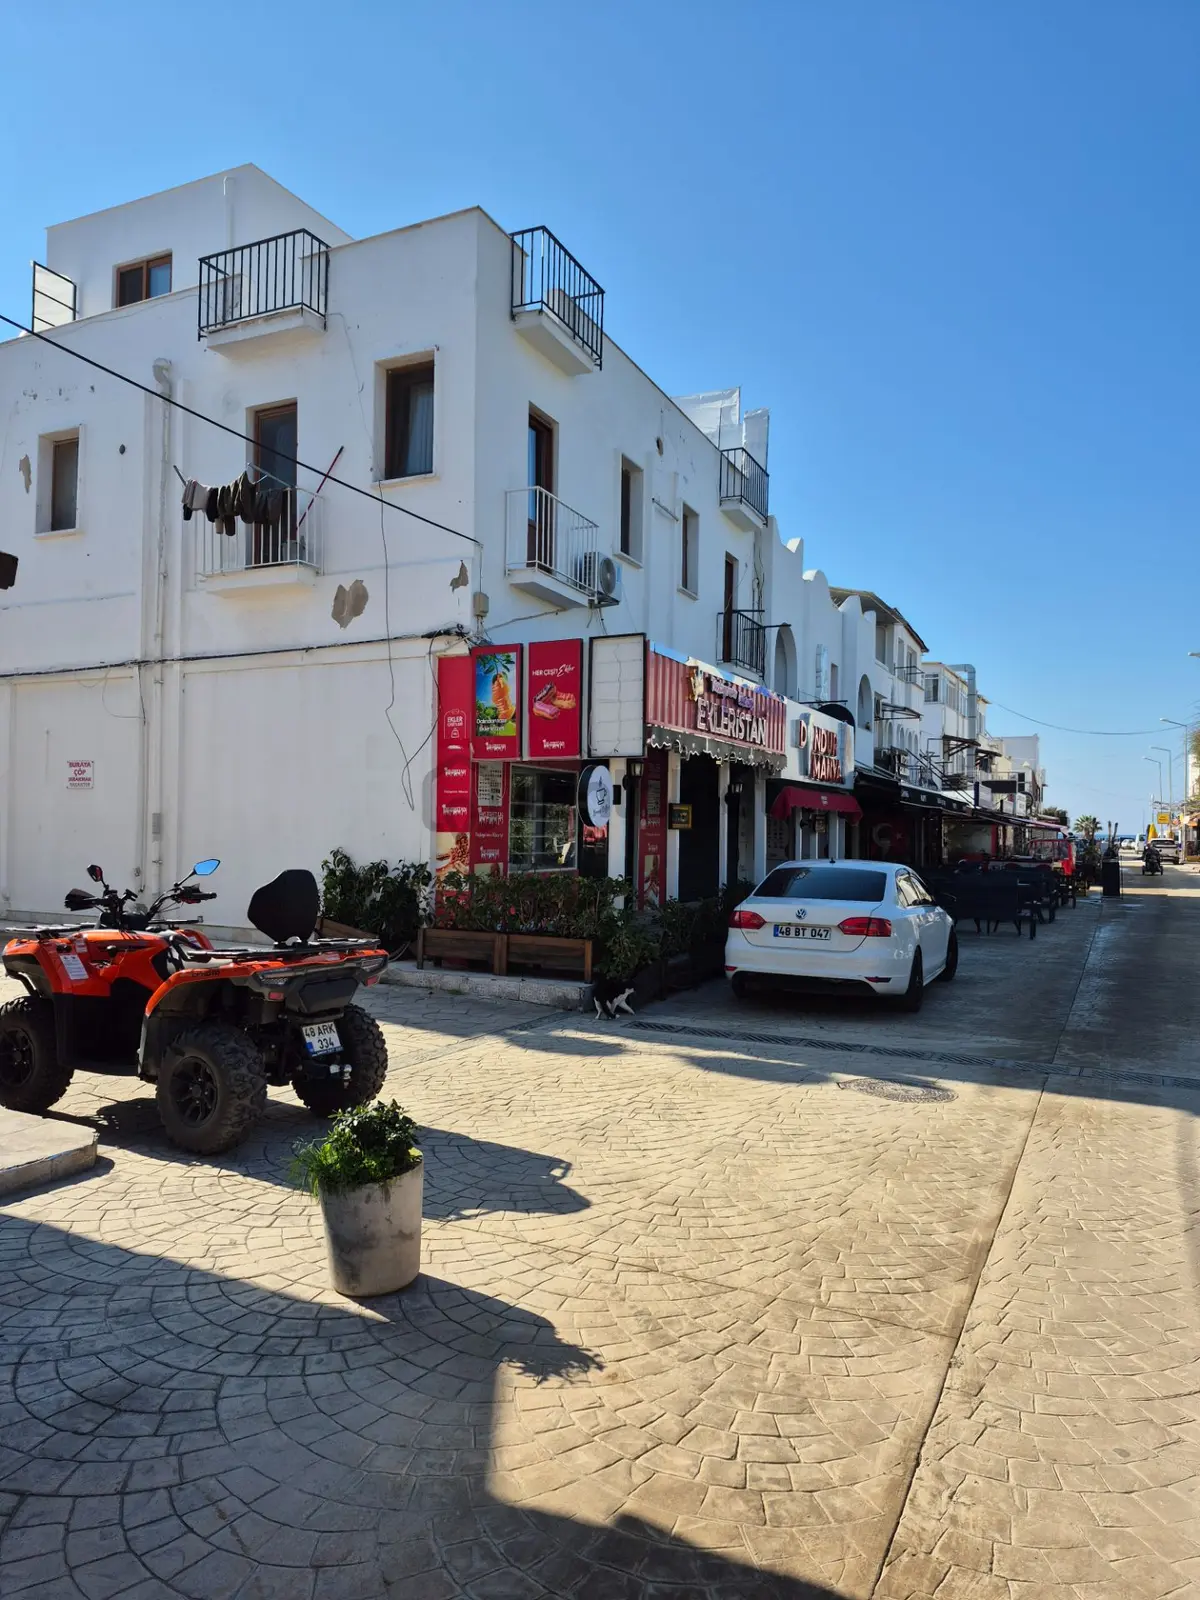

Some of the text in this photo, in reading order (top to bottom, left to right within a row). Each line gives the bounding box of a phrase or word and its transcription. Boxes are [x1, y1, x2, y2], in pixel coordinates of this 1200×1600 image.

[74, 768, 86, 776] ÇÖP
[779, 926, 830, 939] 48 BT 047
[305, 1023, 335, 1038] 48 ARK
[317, 1037, 334, 1050] 334
